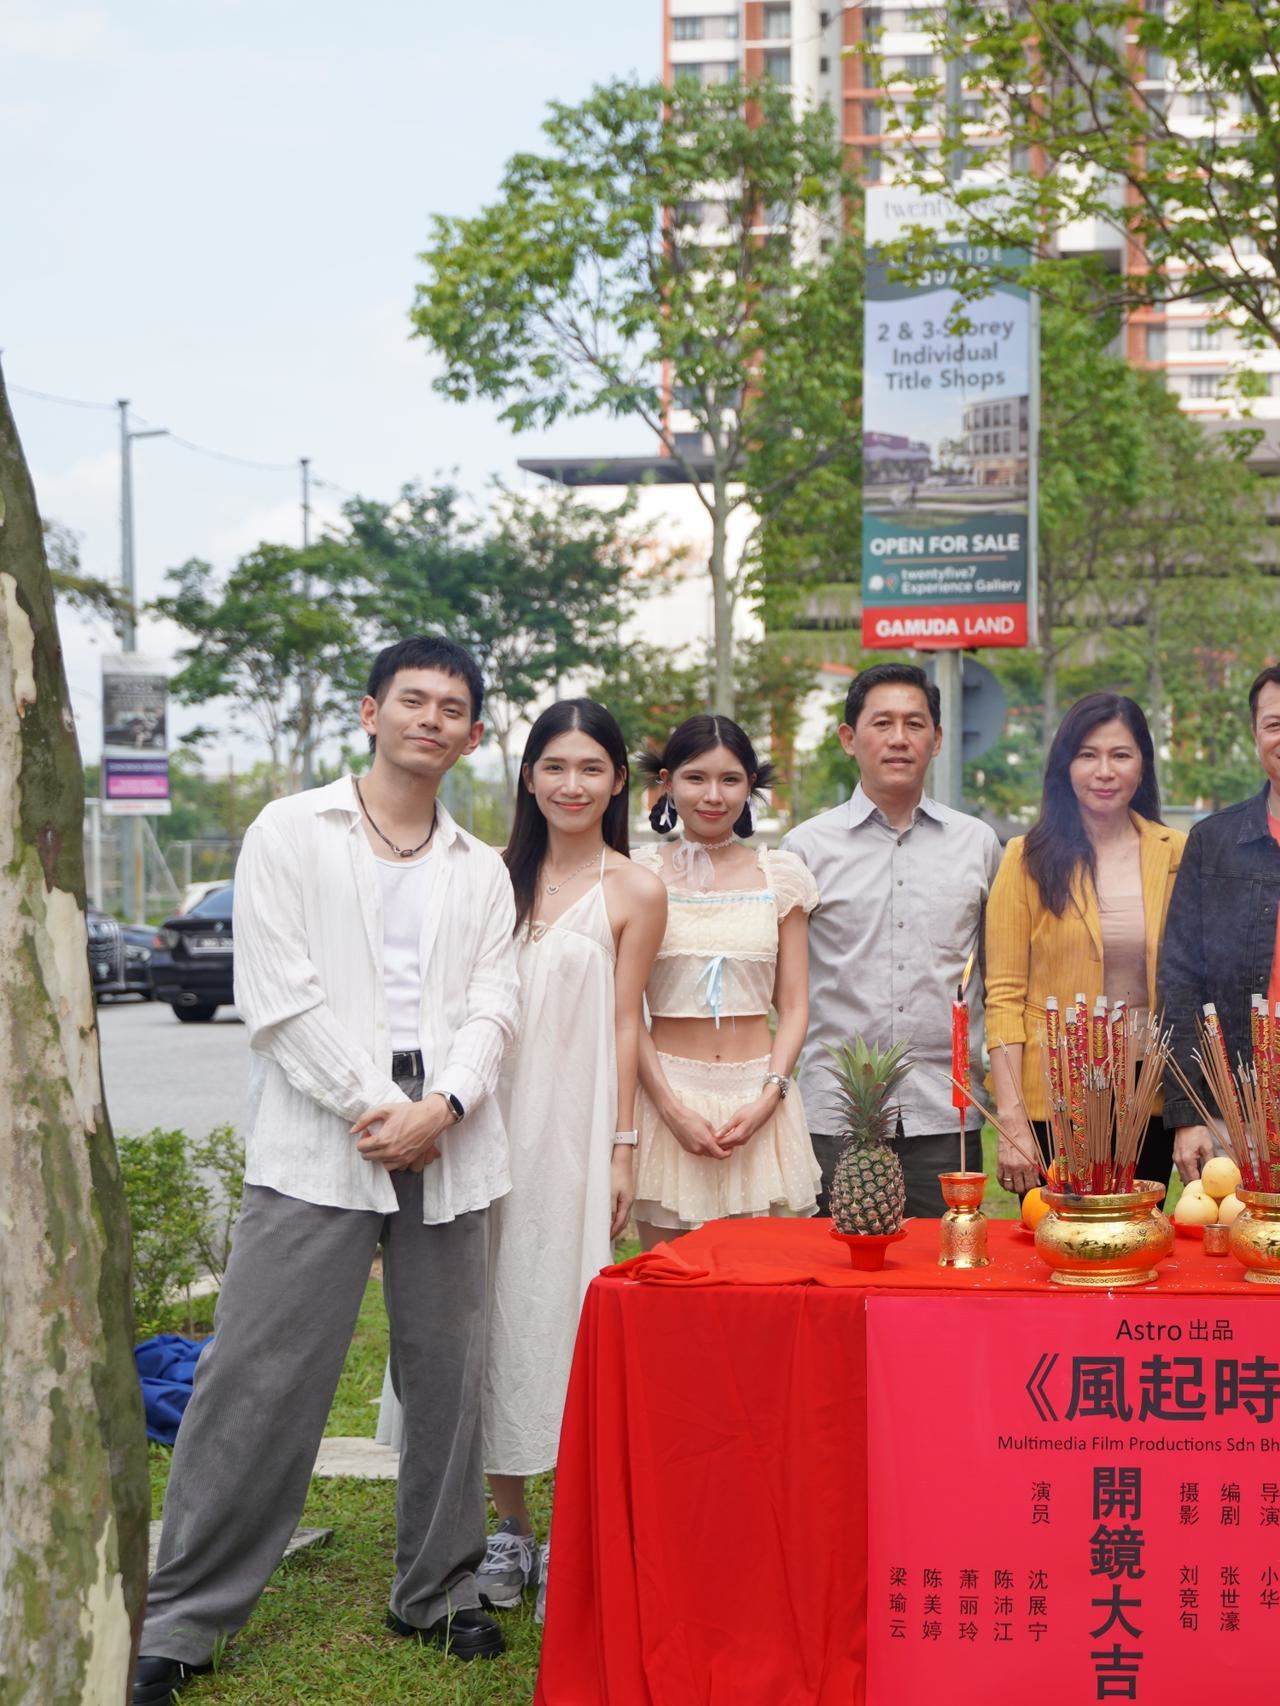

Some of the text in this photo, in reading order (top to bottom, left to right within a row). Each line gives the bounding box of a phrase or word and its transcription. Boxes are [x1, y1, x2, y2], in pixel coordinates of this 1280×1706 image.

[877, 318, 1015, 342] 2 & 3-Sorey
[893, 341, 998, 365] Individual
[885, 369, 1006, 391] Title Shops
[870, 533, 1019, 555] OPEN FOR SALE
[901, 578, 1021, 595] Experience Gallery
[876, 616, 1015, 637] GAMUDA LAND
[1116, 1319, 1233, 1341] Astro 出品
[998, 1436, 1086, 1451] Multimedia
[1092, 1436, 1124, 1450] Film
[1130, 1437, 1221, 1451] Productions
[1227, 1438, 1255, 1451] Sdn
[1032, 1481, 1051, 1524] 演员
[1179, 1482, 1199, 1525] 摄影
[1221, 1483, 1240, 1526] 编剧
[1260, 1483, 1280, 1526] 导演
[889, 1568, 907, 1638] 梁瑜云
[923, 1568, 942, 1640] 陈美婷
[959, 1569, 978, 1641] 萧丽玲
[994, 1569, 1014, 1641] 陈沛江
[1028, 1569, 1048, 1642] 沈展宁
[1088, 1467, 1146, 1701] 開鏡大吉
[1179, 1565, 1199, 1631] 刘竞旬
[1220, 1566, 1240, 1631] 张世濠
[1260, 1567, 1280, 1609] 小华
